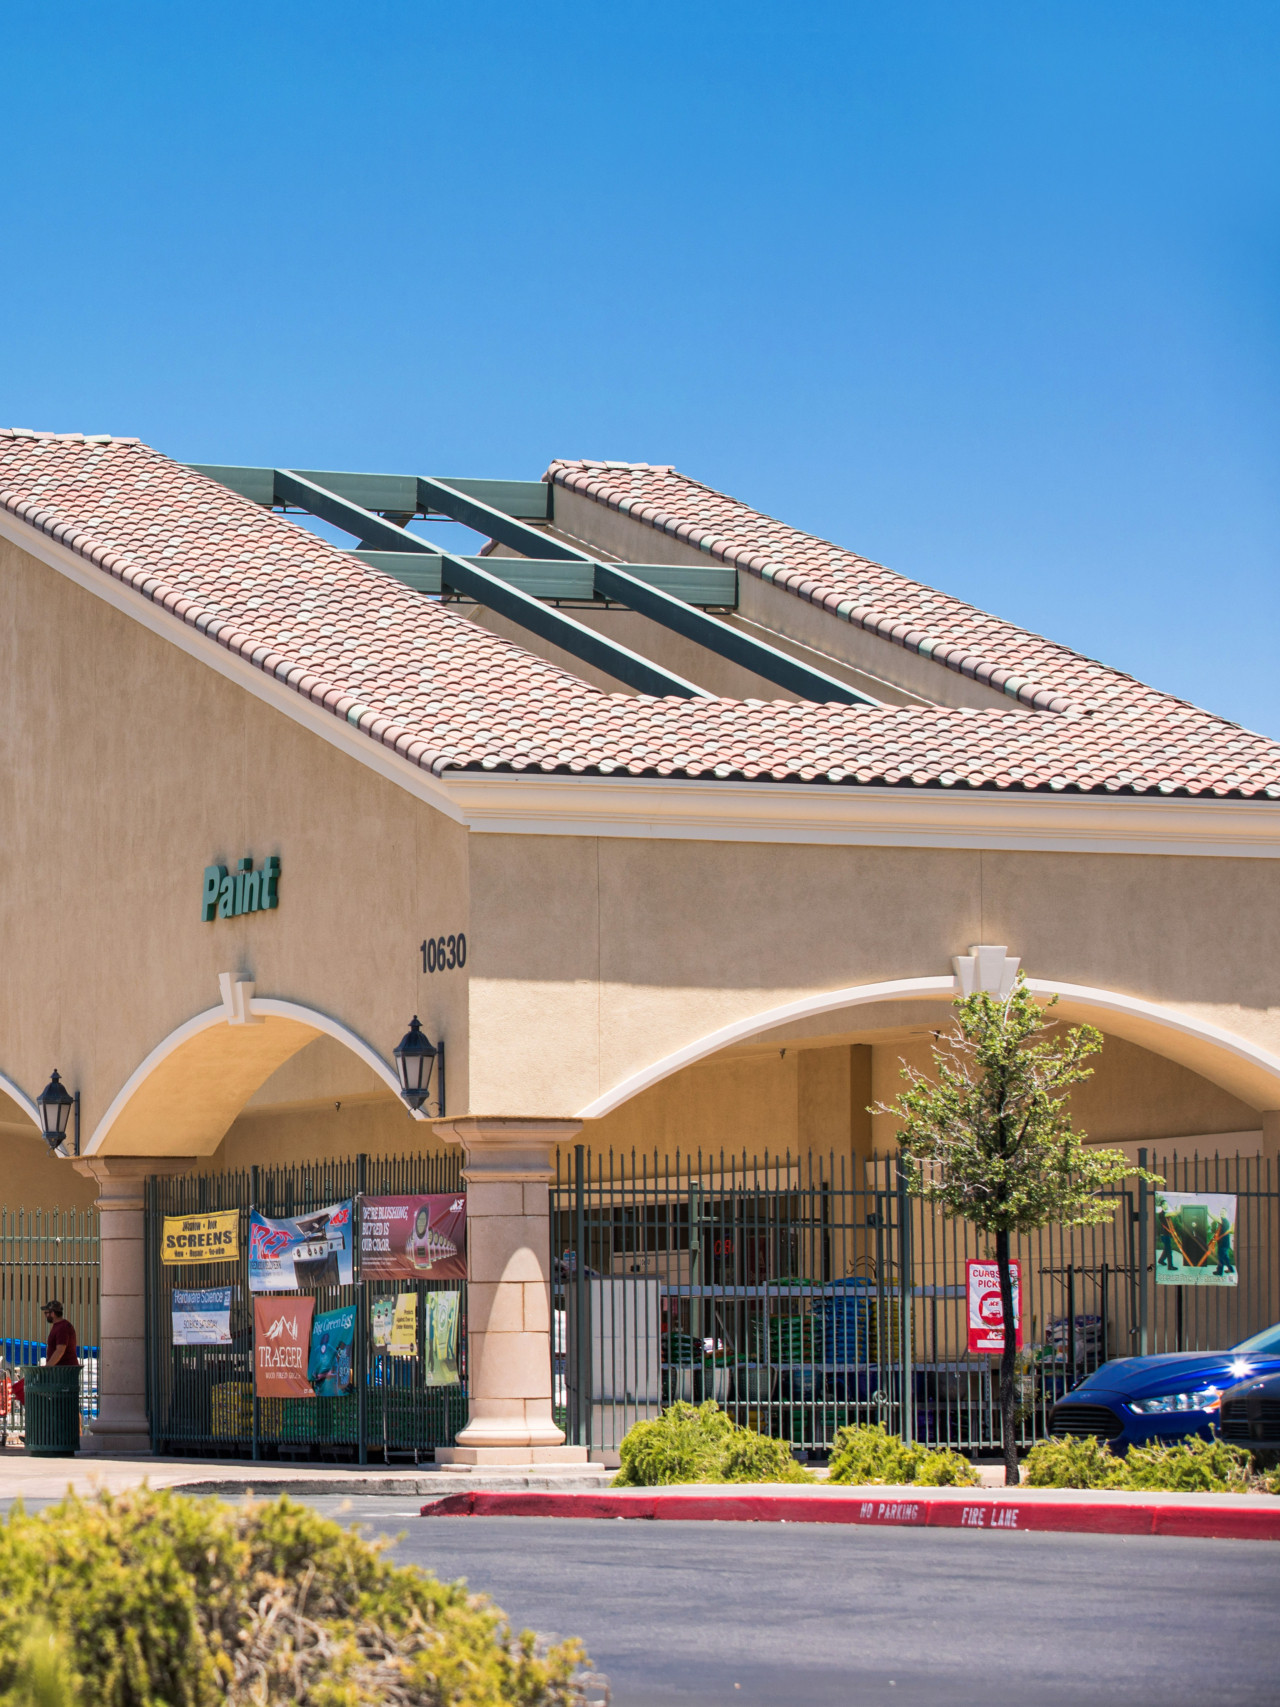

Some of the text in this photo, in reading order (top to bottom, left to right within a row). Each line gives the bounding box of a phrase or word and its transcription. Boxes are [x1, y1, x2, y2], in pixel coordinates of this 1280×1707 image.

[202, 856, 281, 922] Paint
[420, 933, 467, 974] 10630
[330, 1209, 349, 1225] ACE
[166, 1230, 233, 1248] SCREENS
[972, 1269, 1015, 1279] CURBSE
[987, 1331, 1003, 1340] ACE
[259, 1346, 302, 1368] TRAEGER
[860, 1502, 919, 1520] NO PARKING
[962, 1507, 1019, 1528] FIRE LANE
